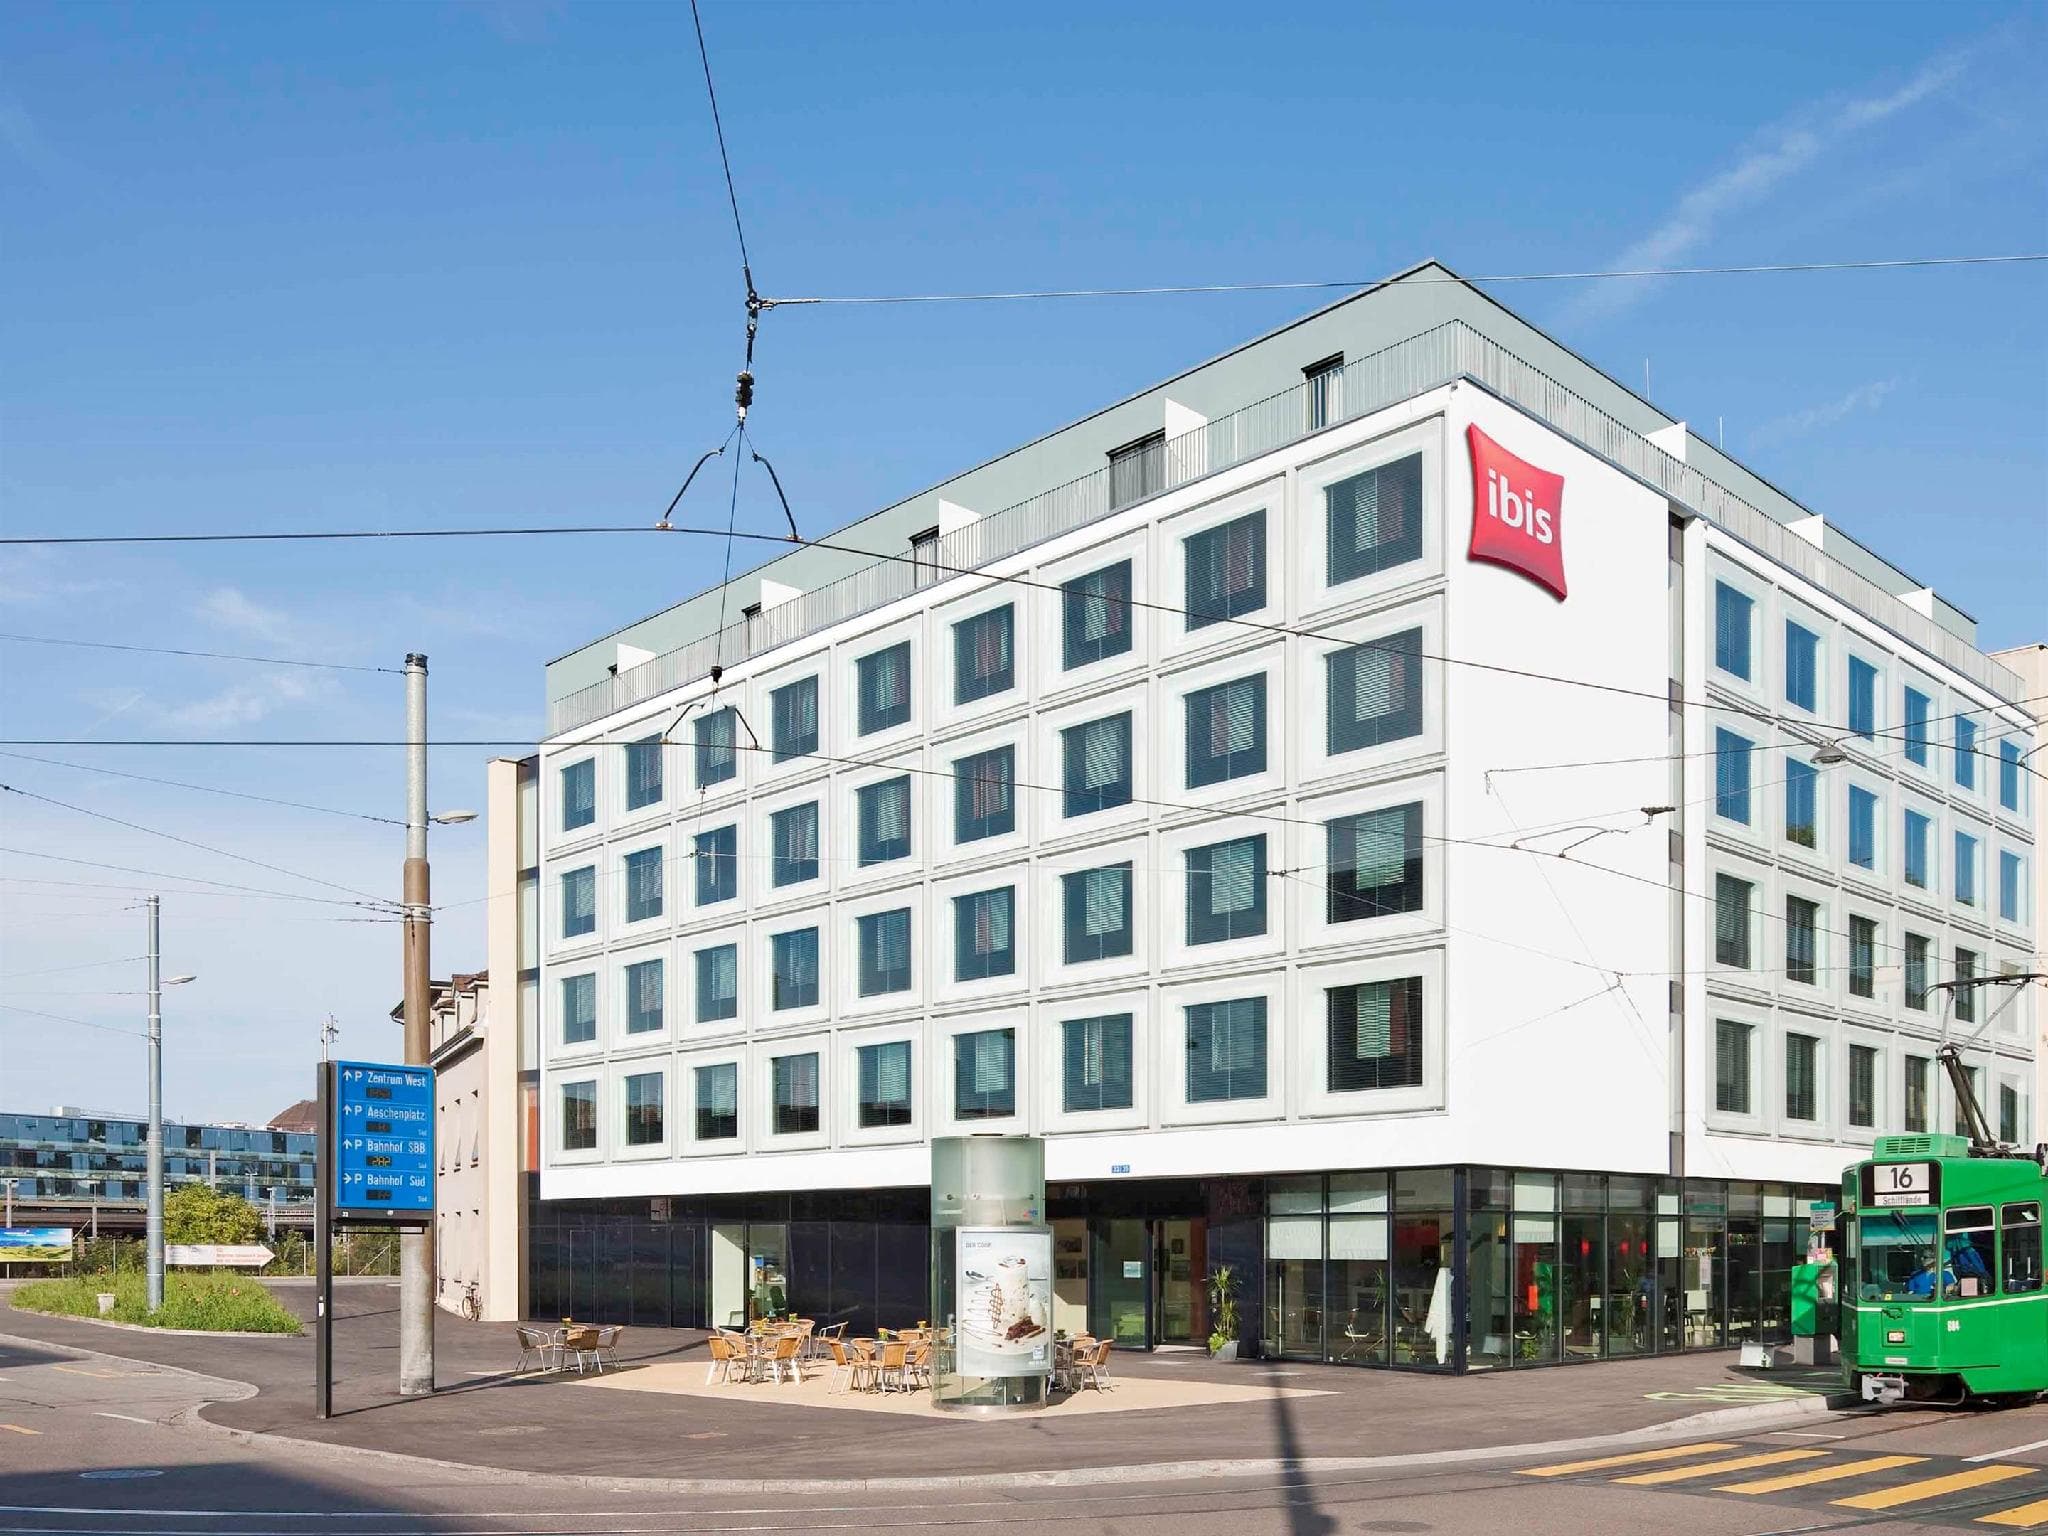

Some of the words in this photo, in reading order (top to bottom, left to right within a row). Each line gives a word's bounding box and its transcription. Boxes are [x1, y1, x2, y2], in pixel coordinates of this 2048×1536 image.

[1488, 467, 1553, 544] ibis
[354, 1070, 363, 1081] P
[367, 1071, 403, 1085] Zentrum
[404, 1073, 426, 1088] West
[354, 1105, 363, 1116] P
[367, 1105, 426, 1121] Aeschenplatz
[354, 1139, 363, 1150] P
[367, 1140, 403, 1153] Bahnhof
[408, 1141, 426, 1154] SBB
[354, 1173, 363, 1184] P
[367, 1173, 403, 1186] Bahnhof
[409, 1175, 426, 1188] Süd
[1890, 1167, 1913, 1189] 16
